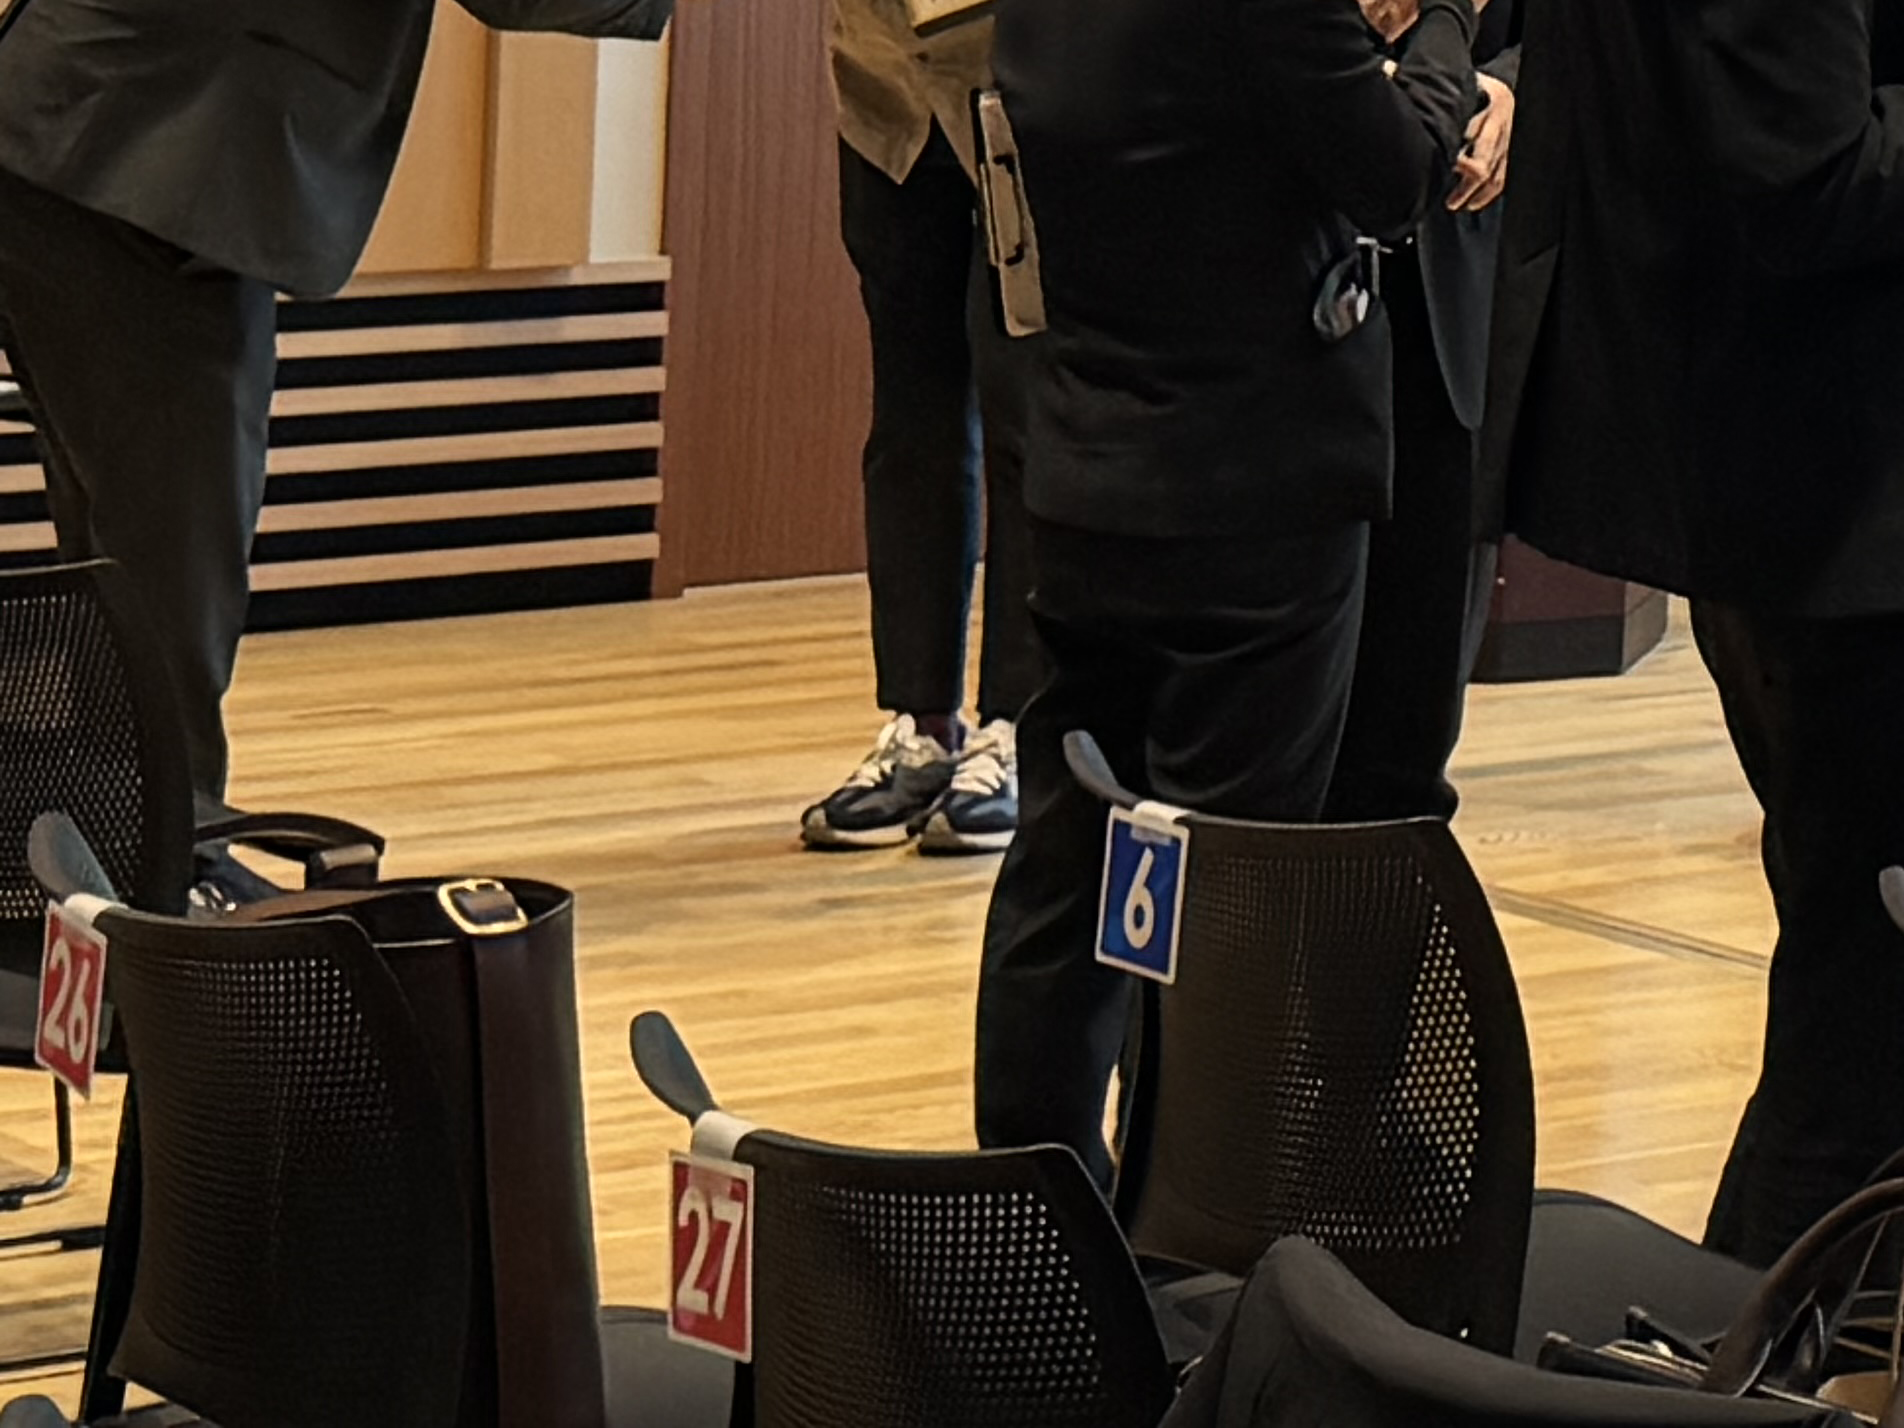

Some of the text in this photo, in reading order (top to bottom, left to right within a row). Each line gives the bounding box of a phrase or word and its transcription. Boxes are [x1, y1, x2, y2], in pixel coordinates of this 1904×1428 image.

[1123, 846, 1155, 949] 6
[43, 935, 92, 1065] 26
[677, 1189, 744, 1321] 27
